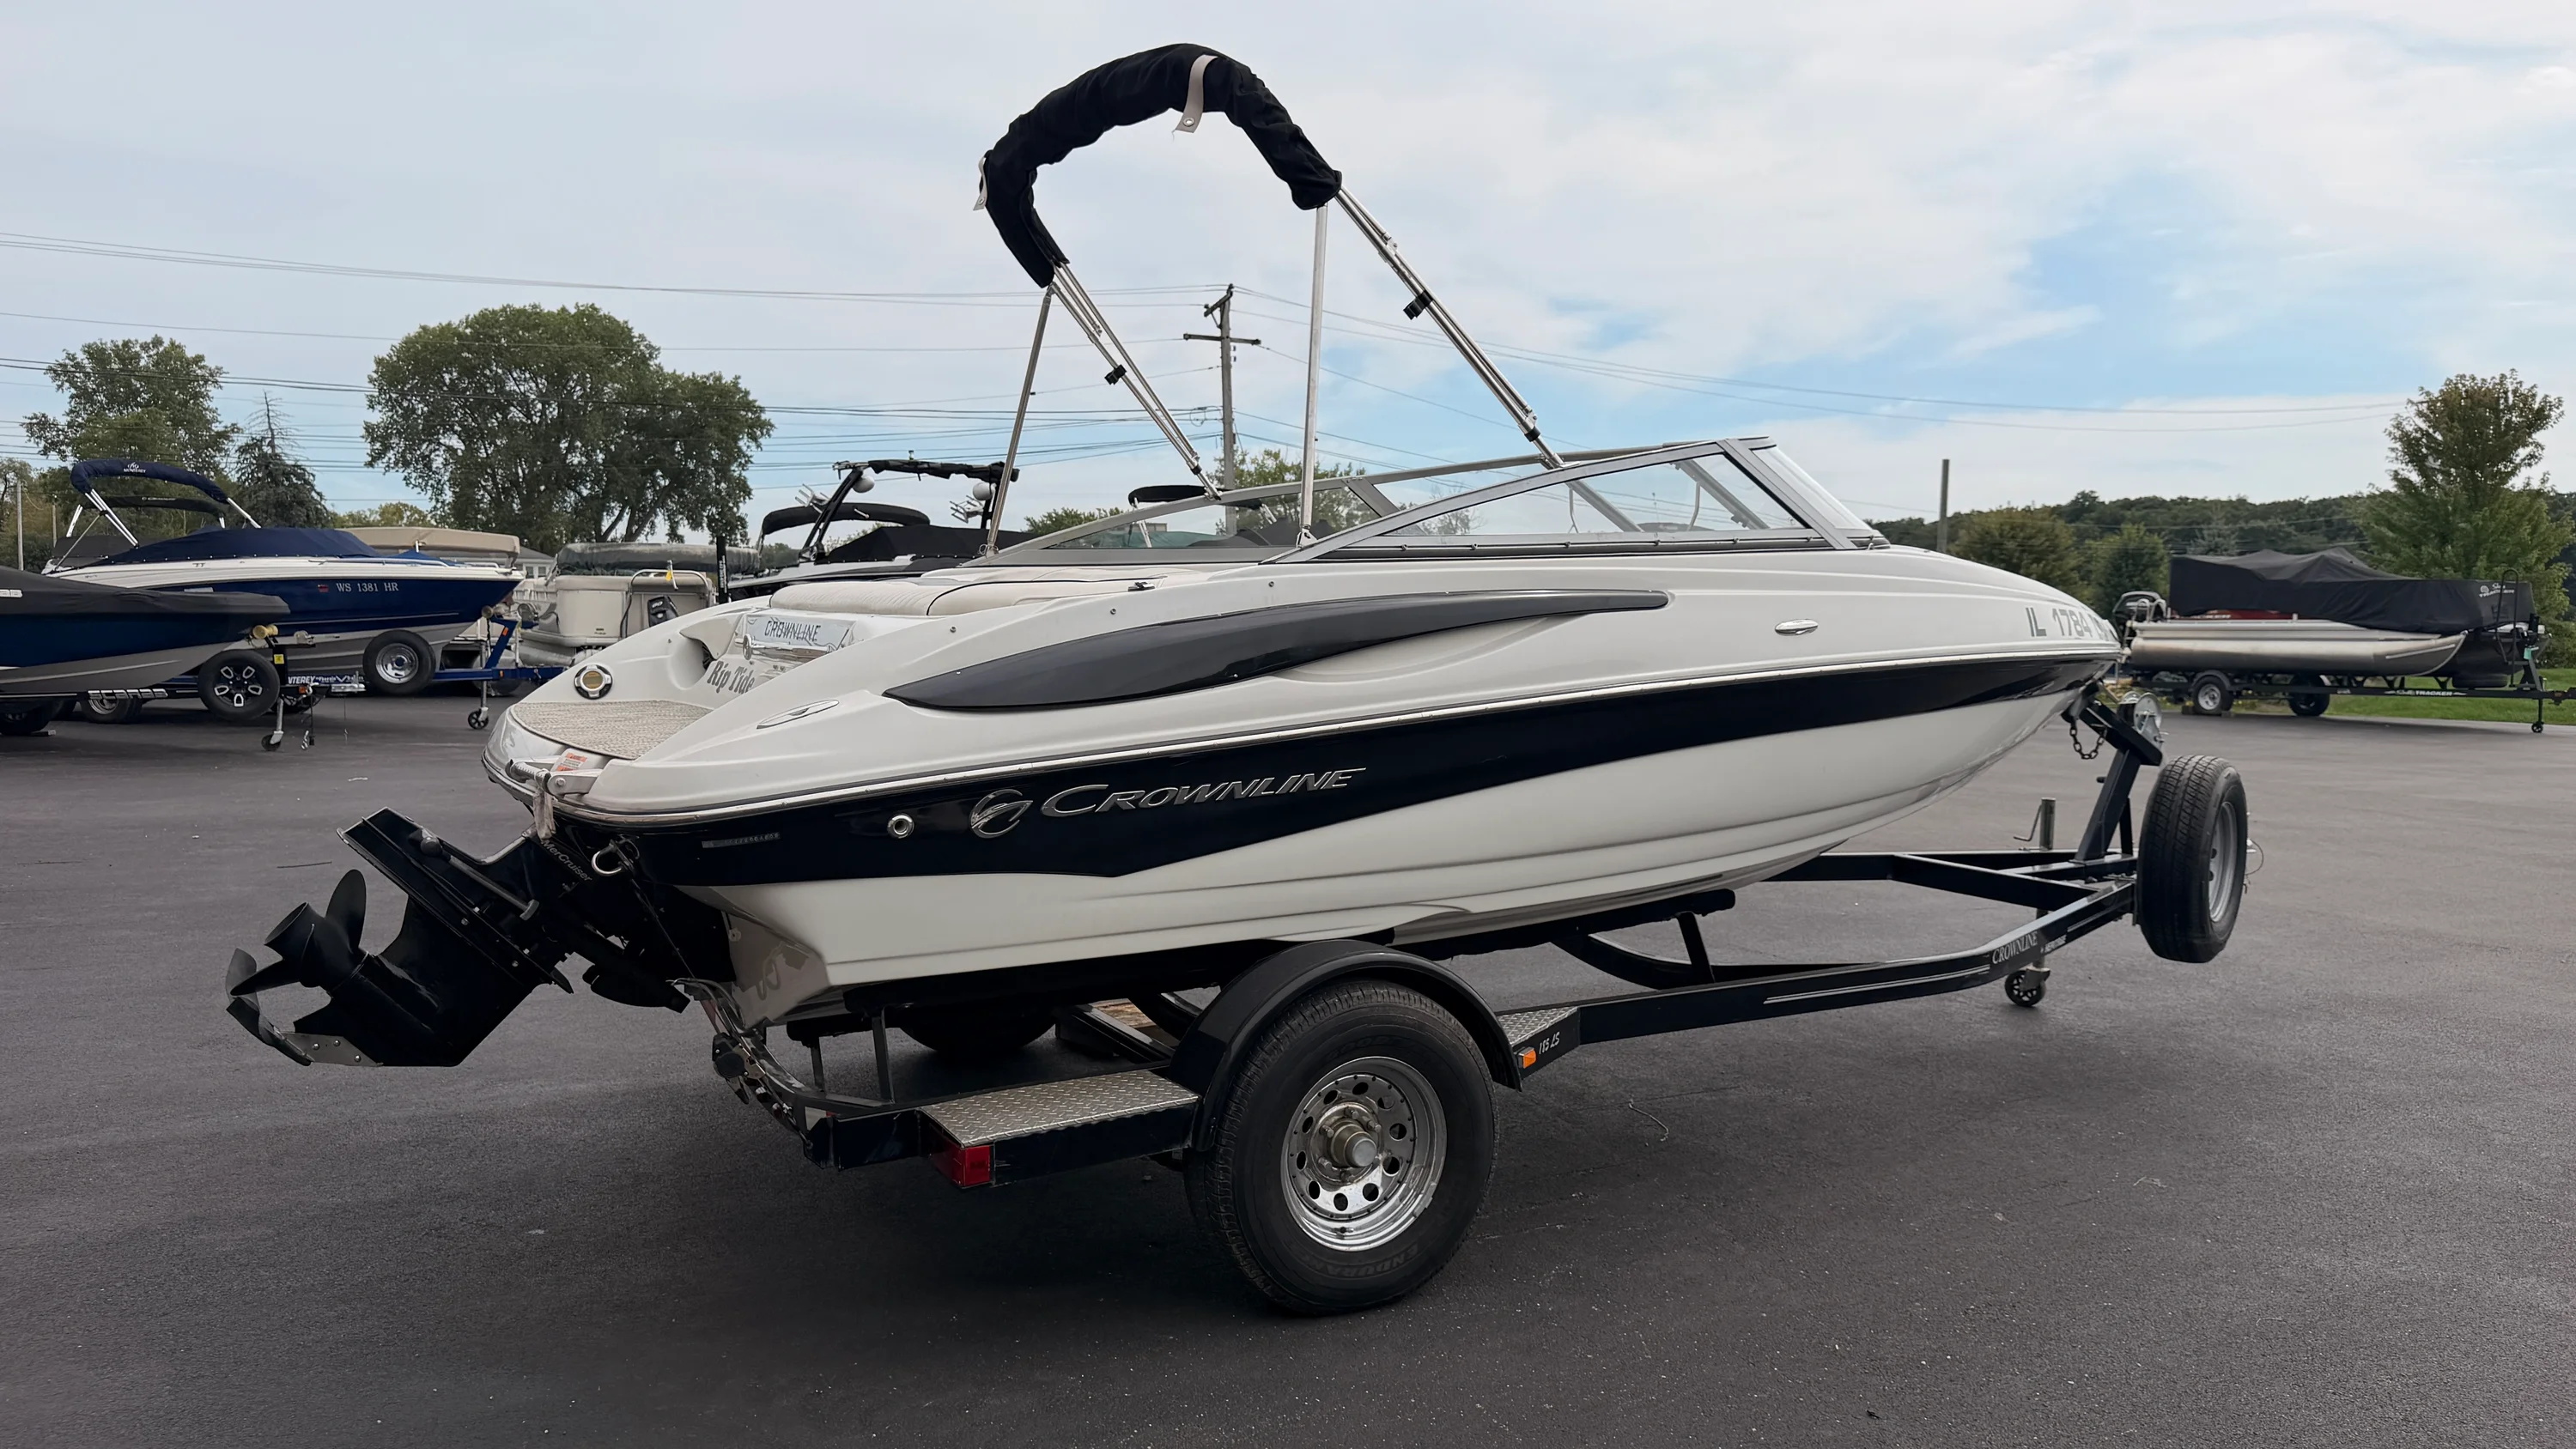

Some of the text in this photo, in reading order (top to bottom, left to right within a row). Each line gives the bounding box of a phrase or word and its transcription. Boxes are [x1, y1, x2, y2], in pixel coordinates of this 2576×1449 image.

[336, 582, 399, 592] WS 1381 HR
[764, 620, 822, 641] CROWNLINE
[2026, 607, 2047, 637] IL
[2052, 608, 2093, 638] 1784
[707, 660, 756, 694] Rip Tide
[1041, 767, 1366, 818] CROWNLINE
[543, 840, 592, 881] MerCruiser
[1992, 931, 2038, 964] CROWNLINE
